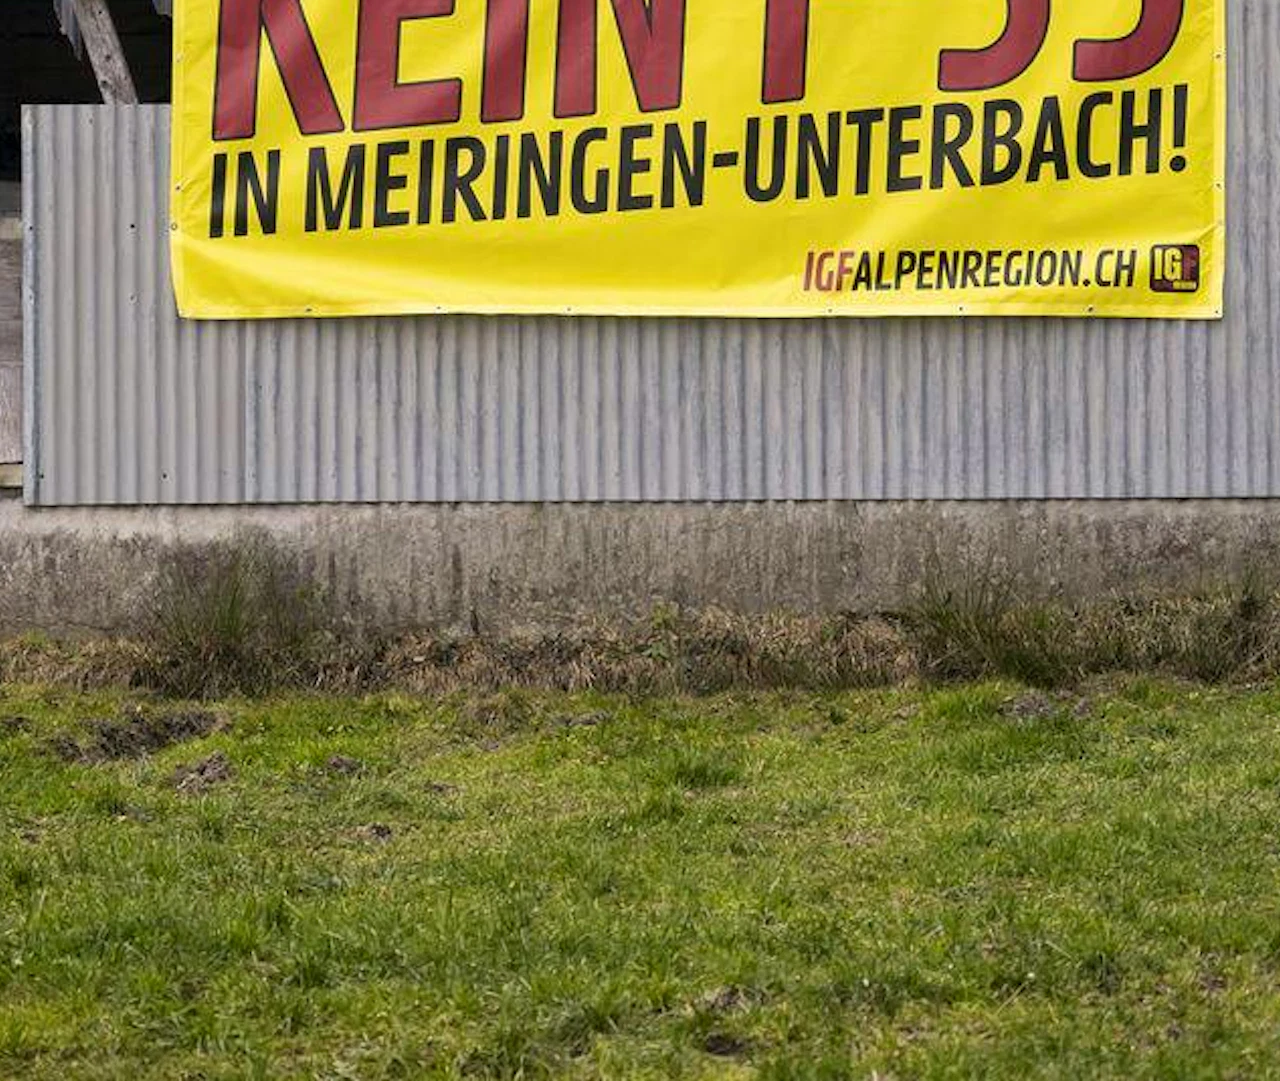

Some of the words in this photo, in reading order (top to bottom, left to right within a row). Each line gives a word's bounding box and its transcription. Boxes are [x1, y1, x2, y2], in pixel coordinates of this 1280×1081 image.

[208, 149, 281, 239] IN
[303, 83, 1189, 233] MEIRINGEN-UNTERBACH!
[802, 249, 1138, 291] IGFALPENREGION.CH
